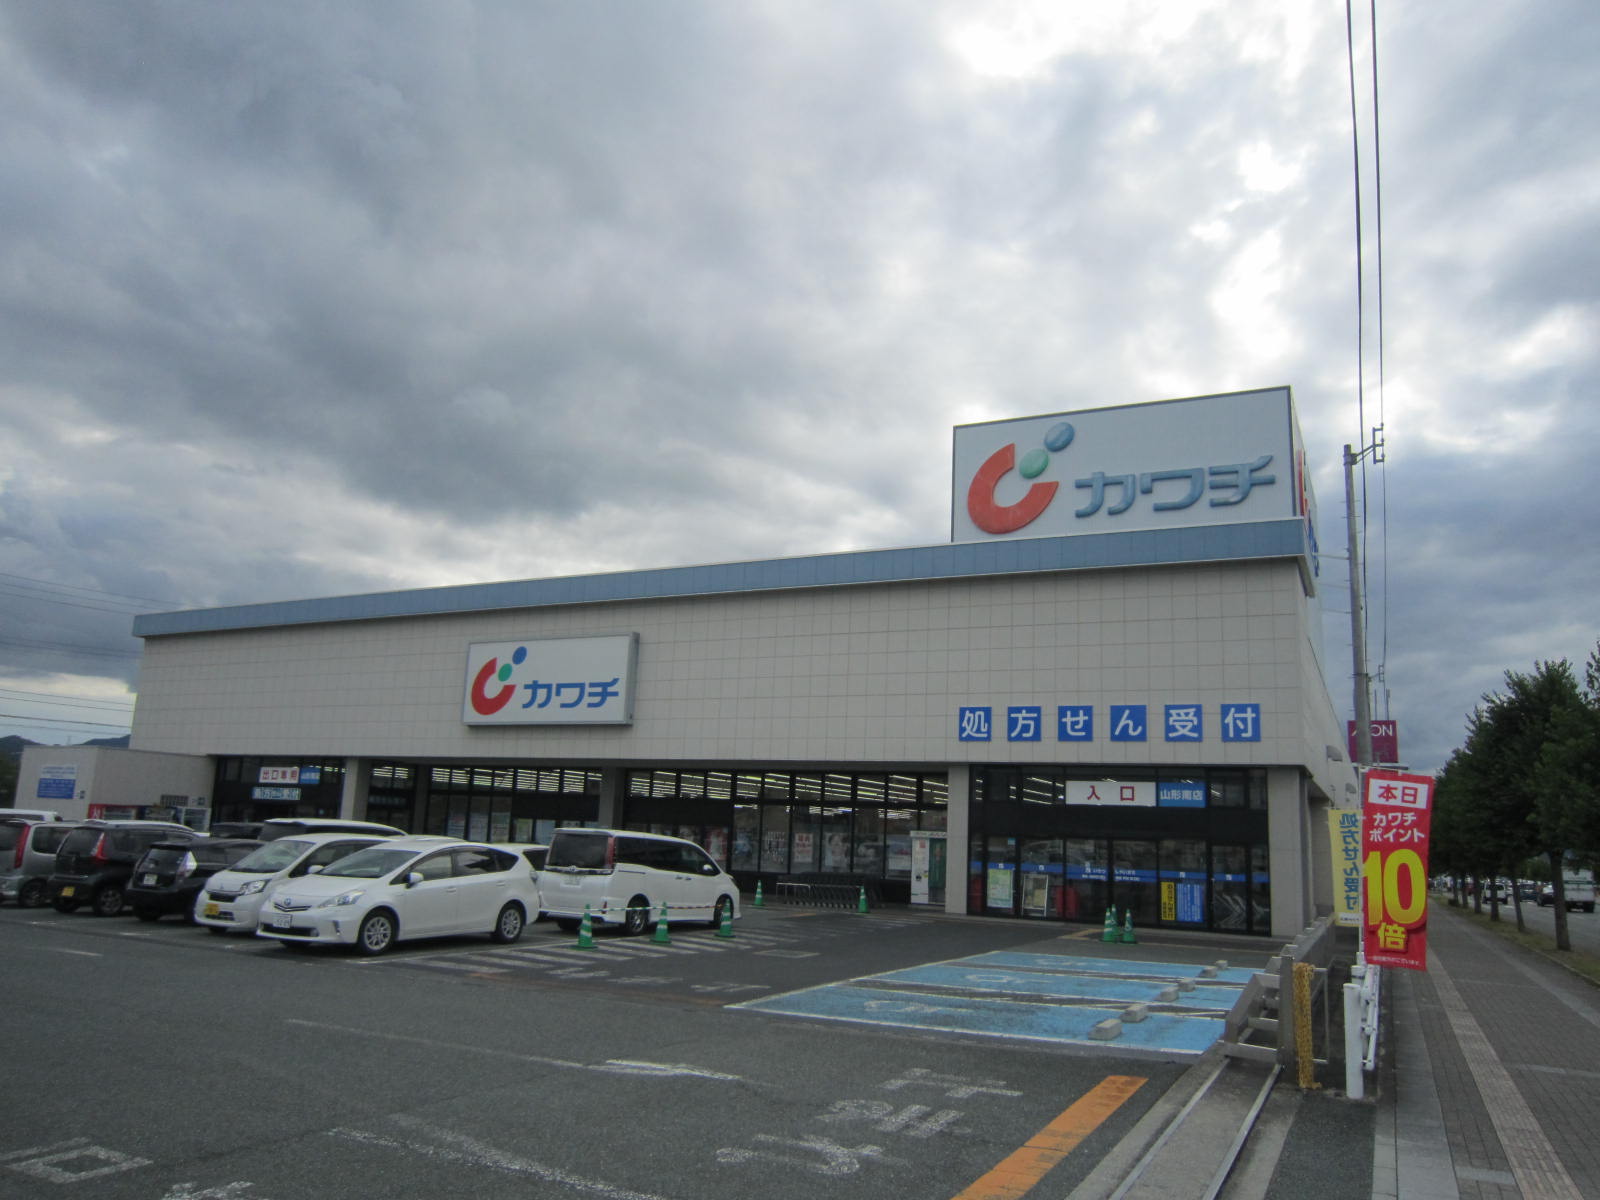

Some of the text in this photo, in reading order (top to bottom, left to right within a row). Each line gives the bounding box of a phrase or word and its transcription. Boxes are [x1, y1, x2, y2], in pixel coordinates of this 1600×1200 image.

[1075, 455, 1276, 519] カワチ
[522, 677, 620, 709] カワチ
[961, 707, 1257, 739] 処方せん受付
[1086, 785, 1136, 801] 入口
[1378, 784, 1418, 805] 本日
[1373, 812, 1417, 827] カワチ
[1369, 827, 1426, 844] ポイント
[1363, 848, 1427, 926] 10
[1378, 922, 1407, 949] 倍
